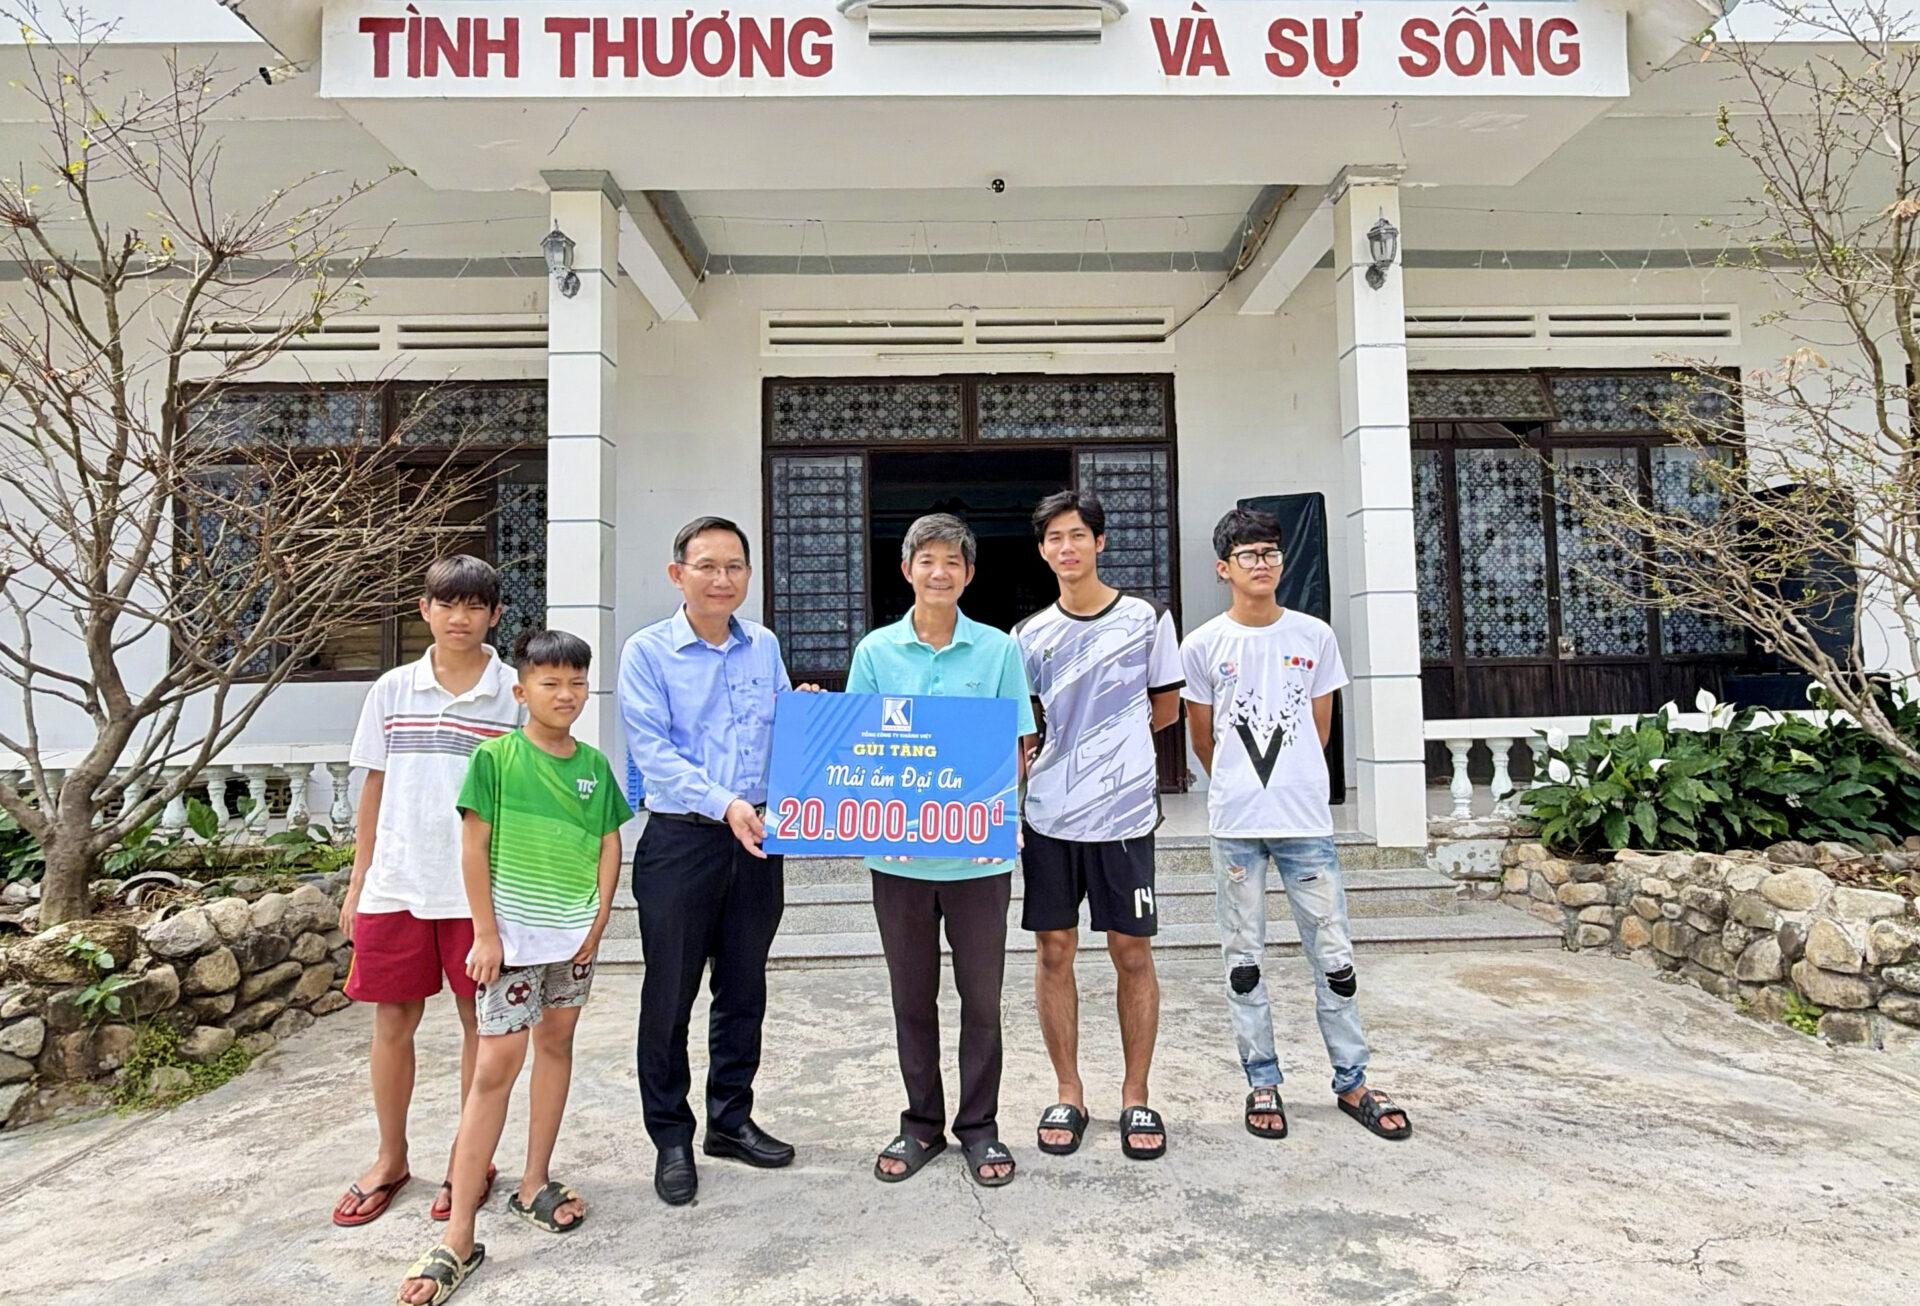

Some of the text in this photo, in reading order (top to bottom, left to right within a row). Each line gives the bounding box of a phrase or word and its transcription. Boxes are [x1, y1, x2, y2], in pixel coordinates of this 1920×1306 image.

[358, 1, 1582, 88] TÌNH THƯƠNG VÀ SỰ SỐNG
[890, 743, 937, 758] TẶNG
[825, 764, 963, 793] Mái ấm Đại An
[1134, 886, 1154, 919] 14
[1048, 1108, 1071, 1120] PH
[1132, 1110, 1153, 1123] PH
